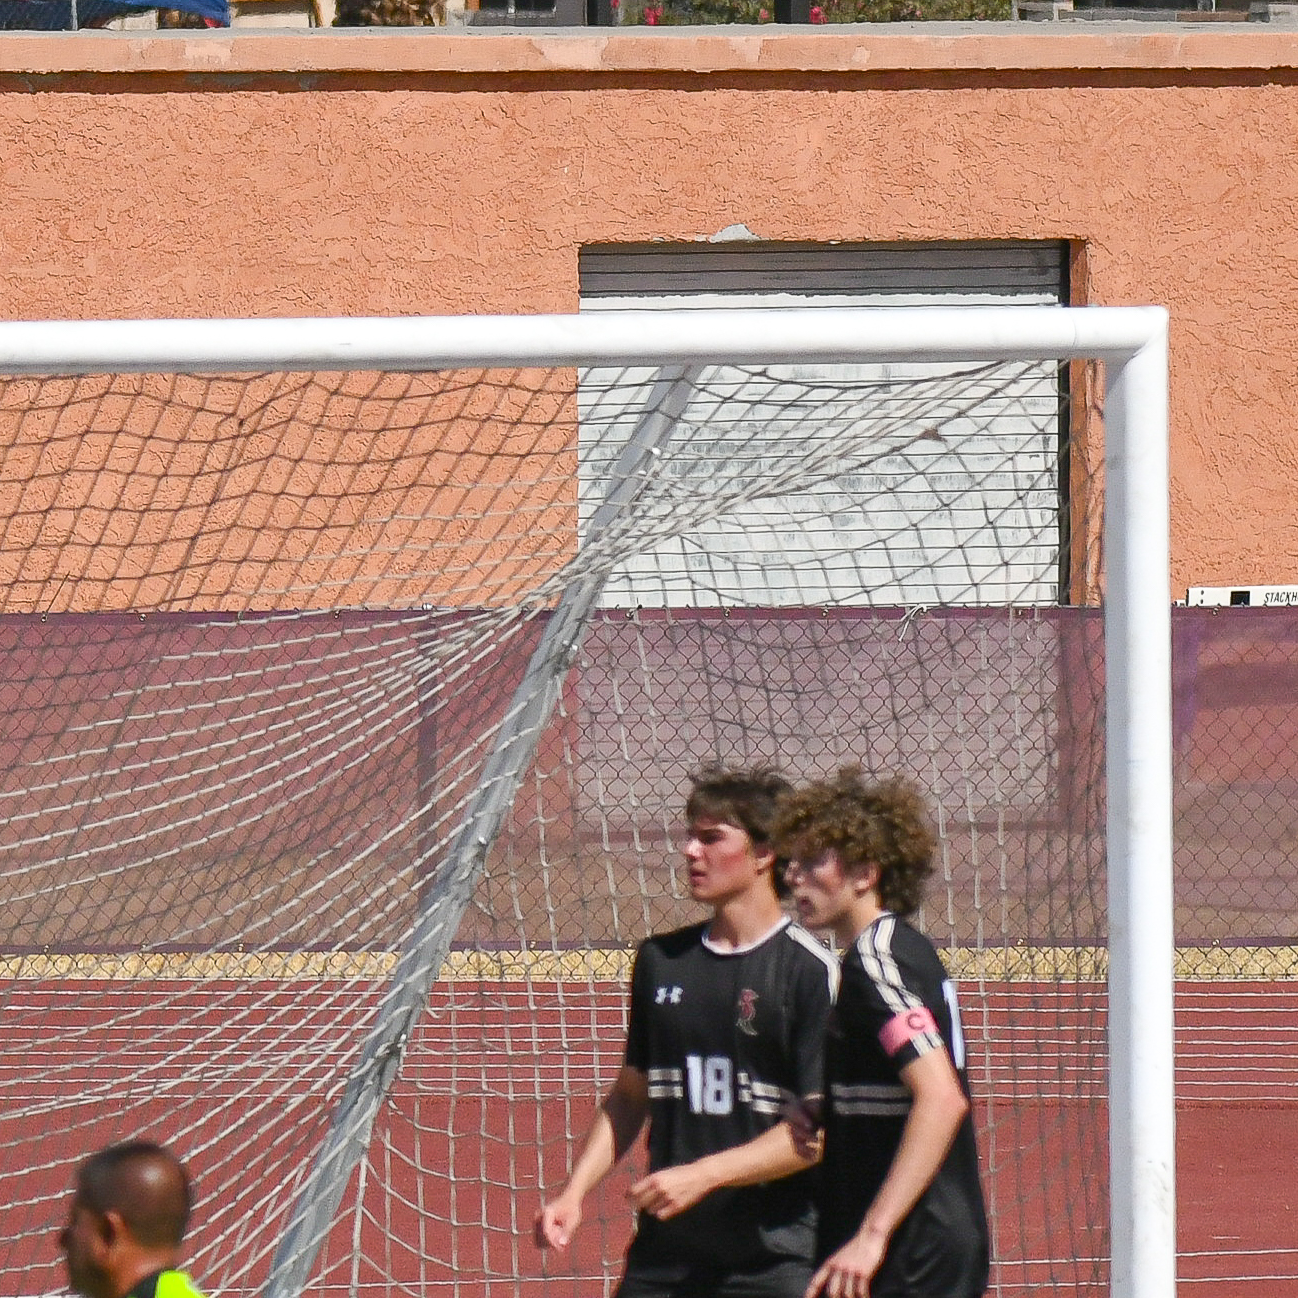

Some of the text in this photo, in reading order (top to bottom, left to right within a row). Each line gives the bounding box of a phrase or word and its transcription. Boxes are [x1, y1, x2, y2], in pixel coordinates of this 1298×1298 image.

[1265, 591, 1298, 603] STACKH
[907, 1012, 926, 1031] C
[686, 1054, 734, 1116] 18
